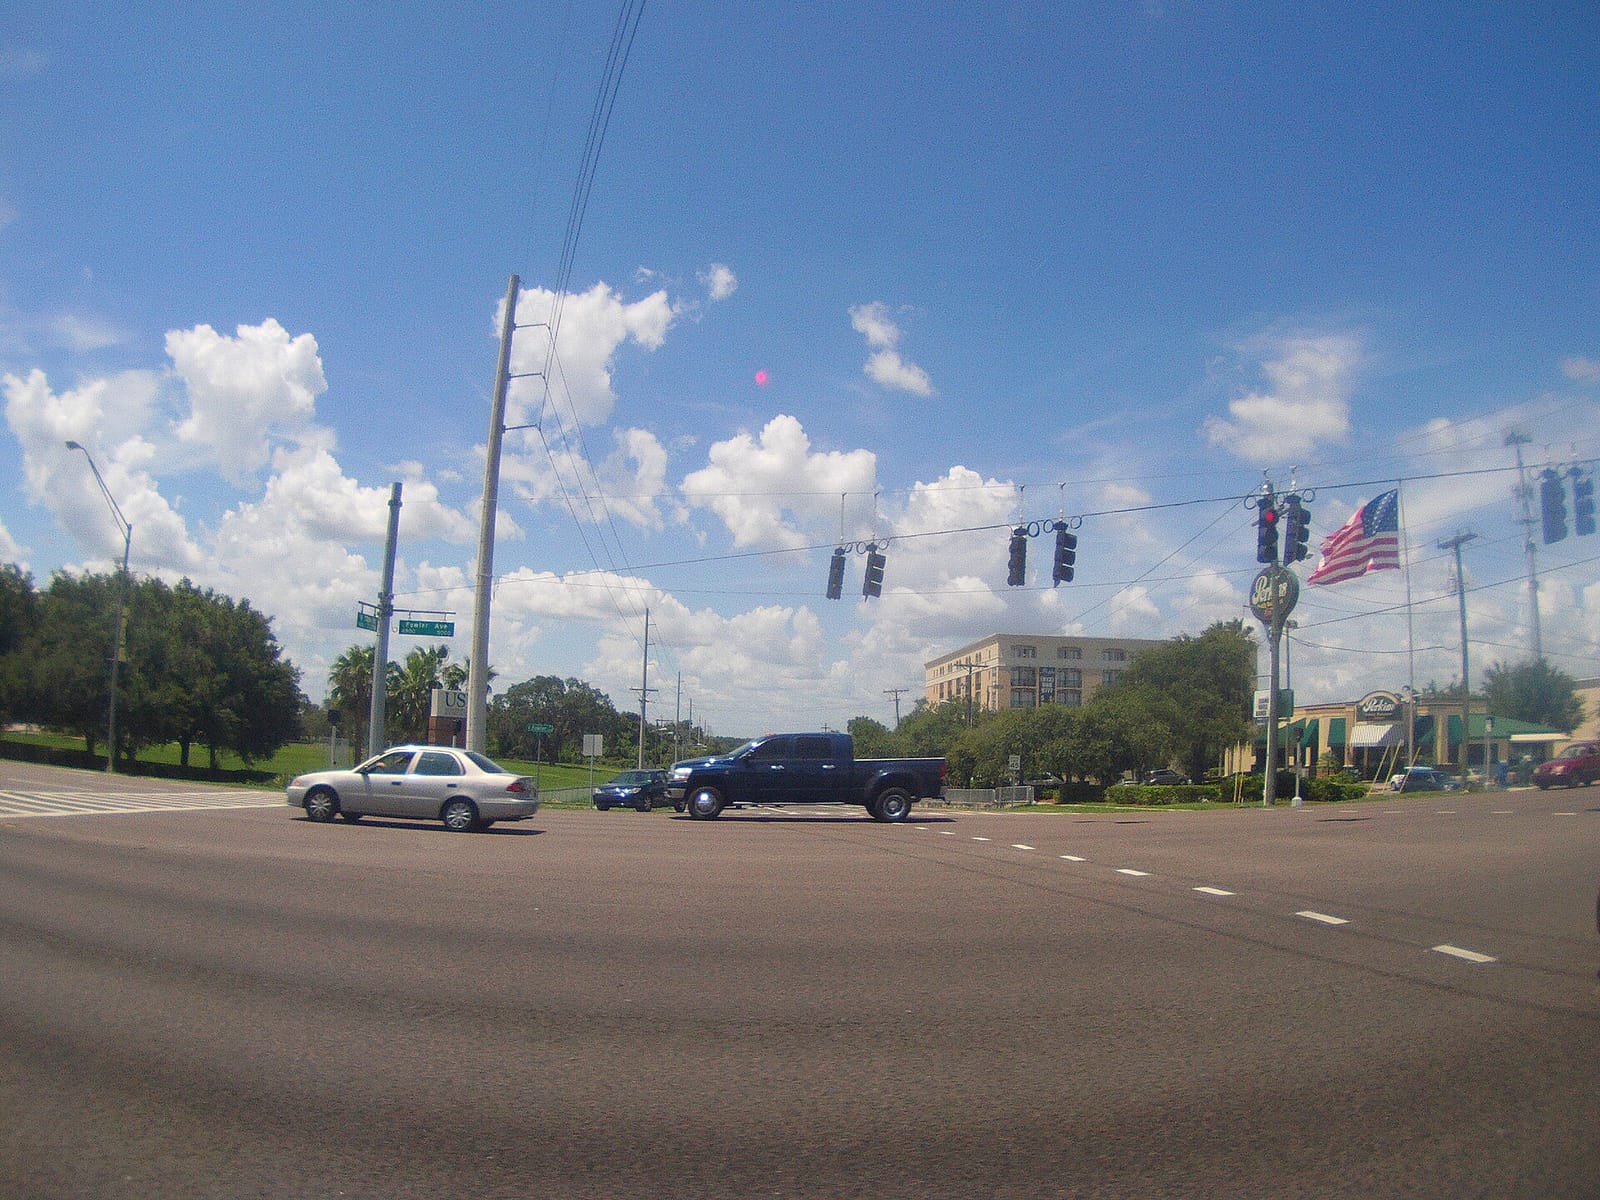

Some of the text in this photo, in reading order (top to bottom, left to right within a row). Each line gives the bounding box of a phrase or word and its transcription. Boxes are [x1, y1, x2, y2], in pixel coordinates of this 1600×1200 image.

[1252, 575, 1288, 604] Perns
[405, 621, 428, 629] Fowler
[445, 691, 468, 707] US
